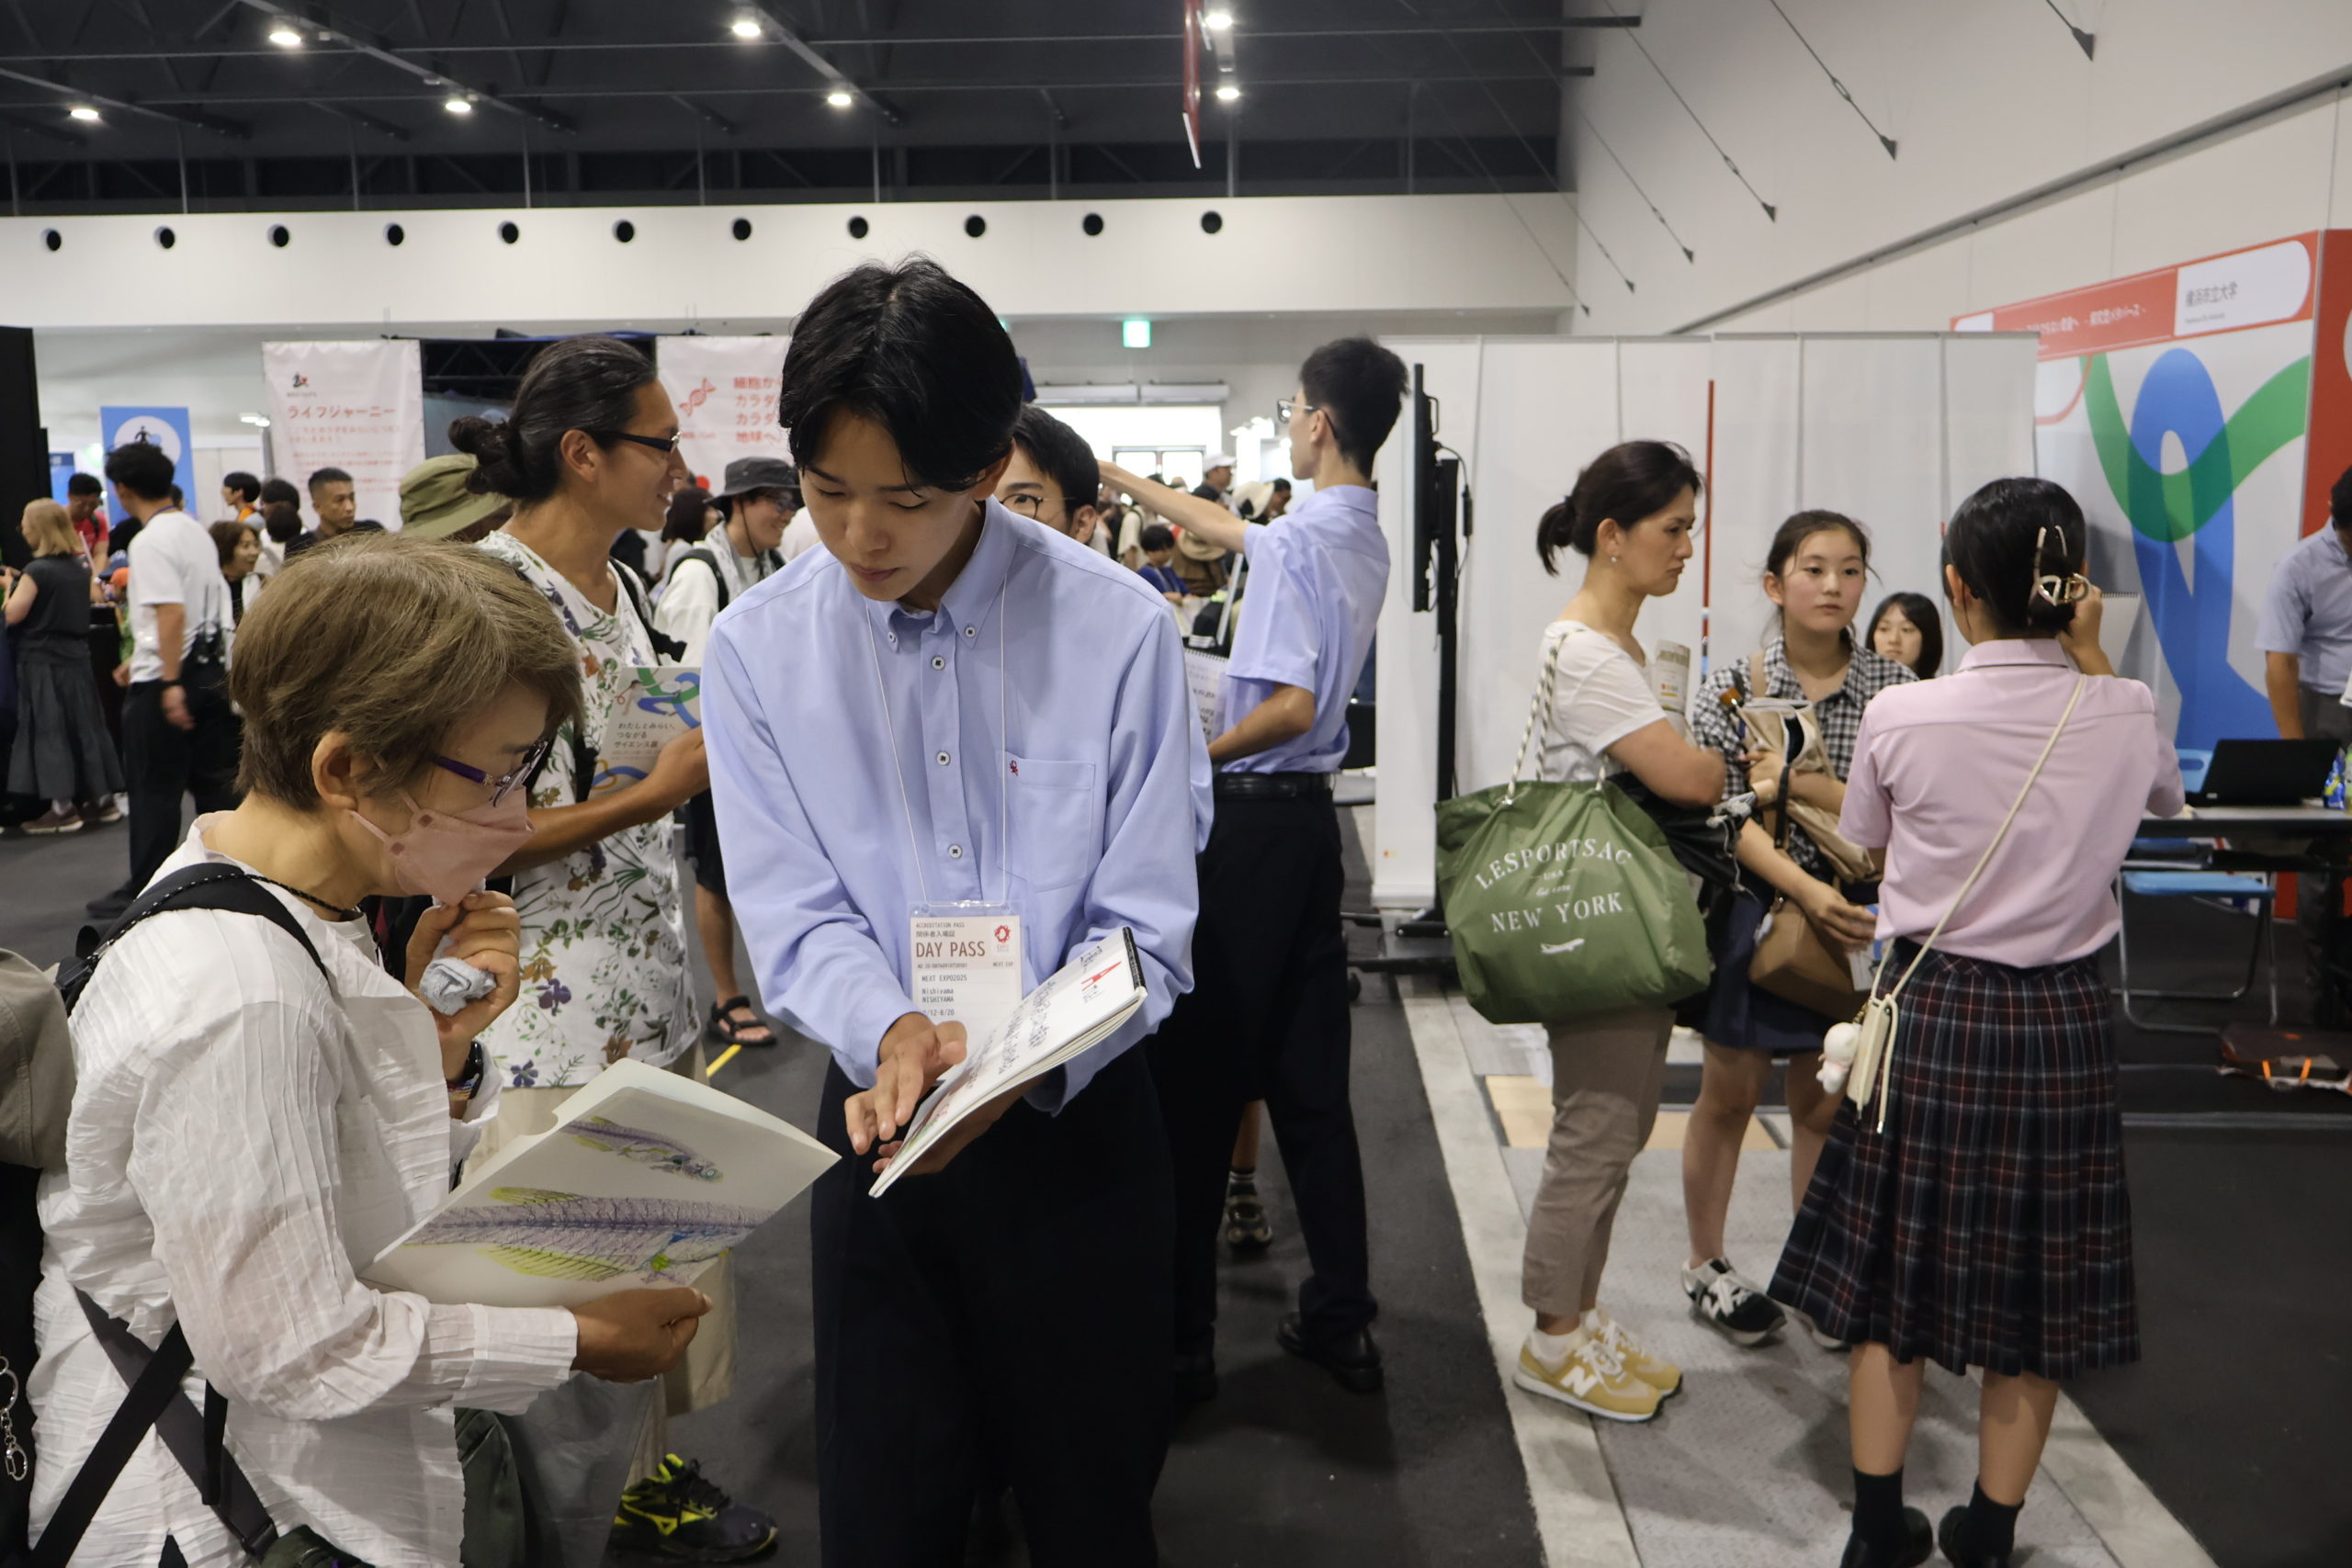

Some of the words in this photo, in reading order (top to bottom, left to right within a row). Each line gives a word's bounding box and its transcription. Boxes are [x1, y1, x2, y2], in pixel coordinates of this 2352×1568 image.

[288, 406, 396, 419] ライフジャーニー
[617, 731, 648, 739] つながる
[1475, 838, 1633, 890] LESPORTSAC
[1491, 907, 1544, 933] NEW
[1555, 892, 1623, 923] YORK
[916, 942, 943, 957] DAY
[950, 941, 986, 957] PASS
[939, 974, 967, 982] EXPO2025
[1560, 1365, 1601, 1397] N
